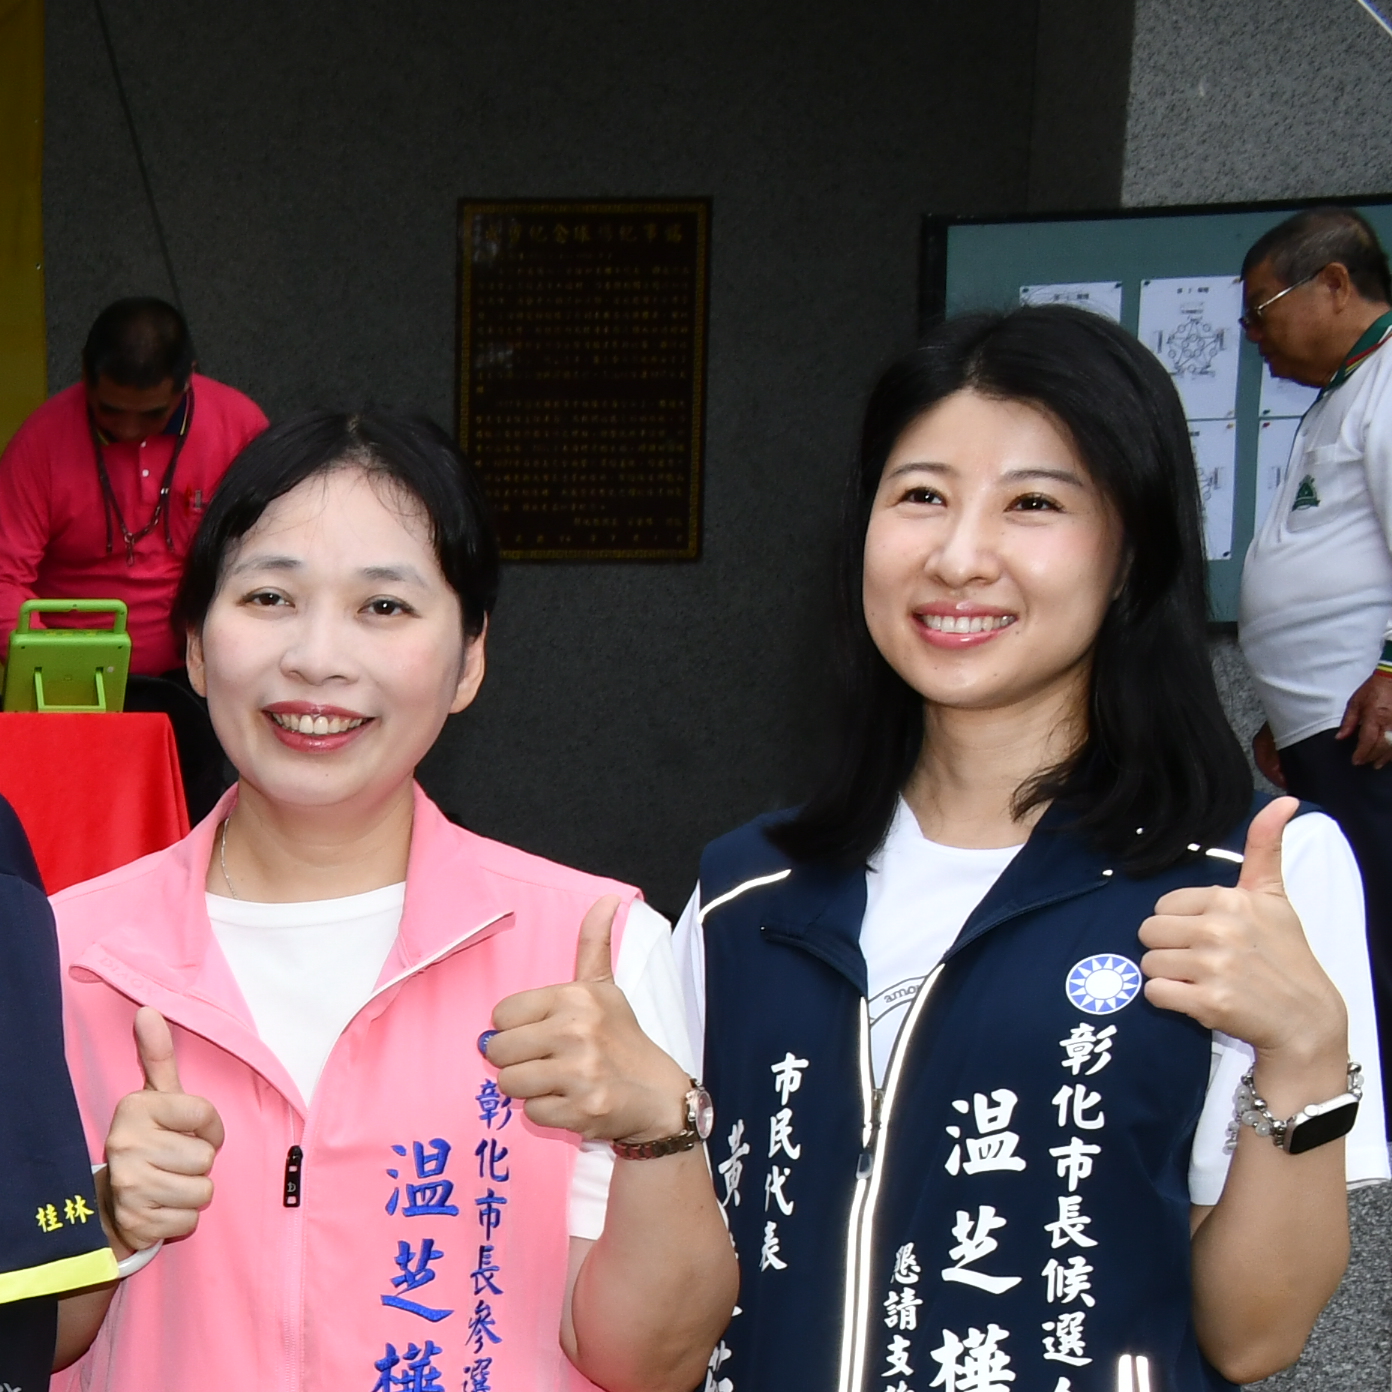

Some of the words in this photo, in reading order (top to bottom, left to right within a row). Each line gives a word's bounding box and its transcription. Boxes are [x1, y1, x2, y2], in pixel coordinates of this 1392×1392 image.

[34, 1194, 95, 1234] 桂林
[758, 1051, 809, 1273] 市民代表
